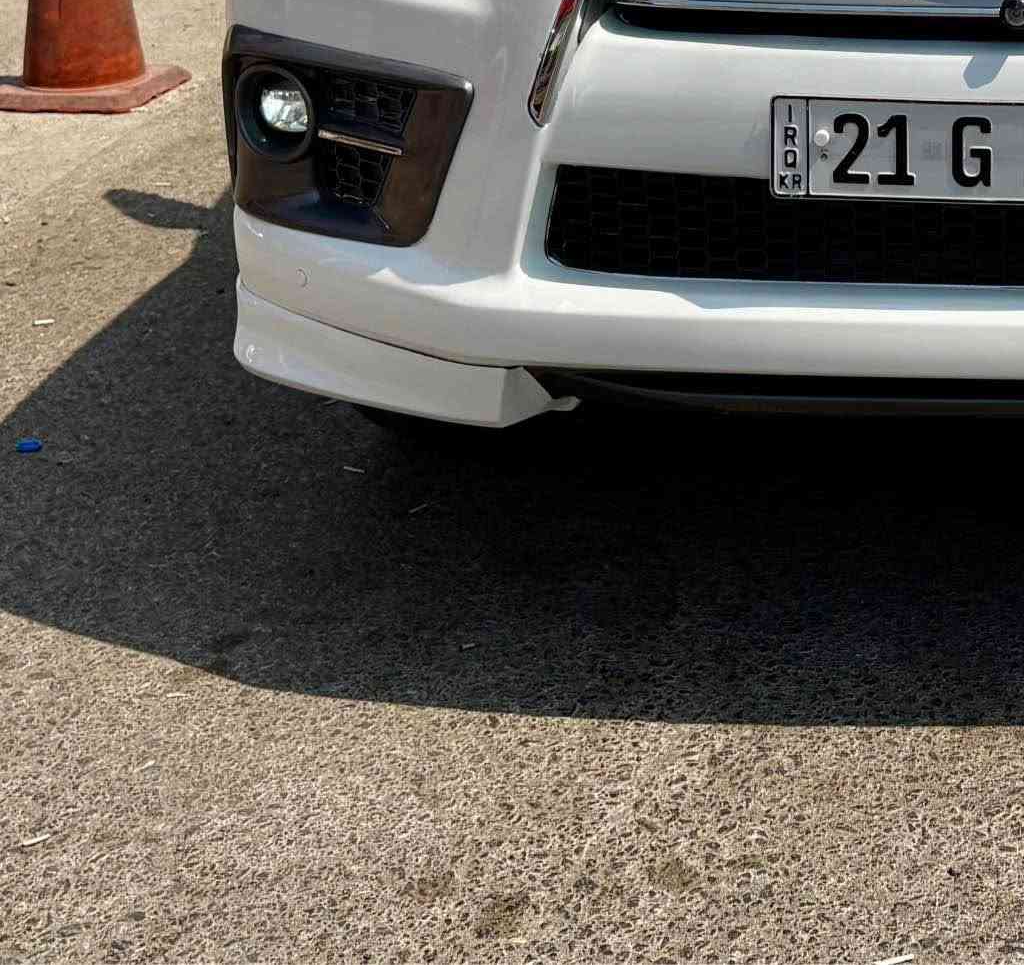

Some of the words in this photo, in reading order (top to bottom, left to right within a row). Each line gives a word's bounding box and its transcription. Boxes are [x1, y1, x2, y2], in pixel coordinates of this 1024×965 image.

[832, 113, 916, 186] 21
[951, 116, 992, 188] G
[779, 173, 802, 190] KR
